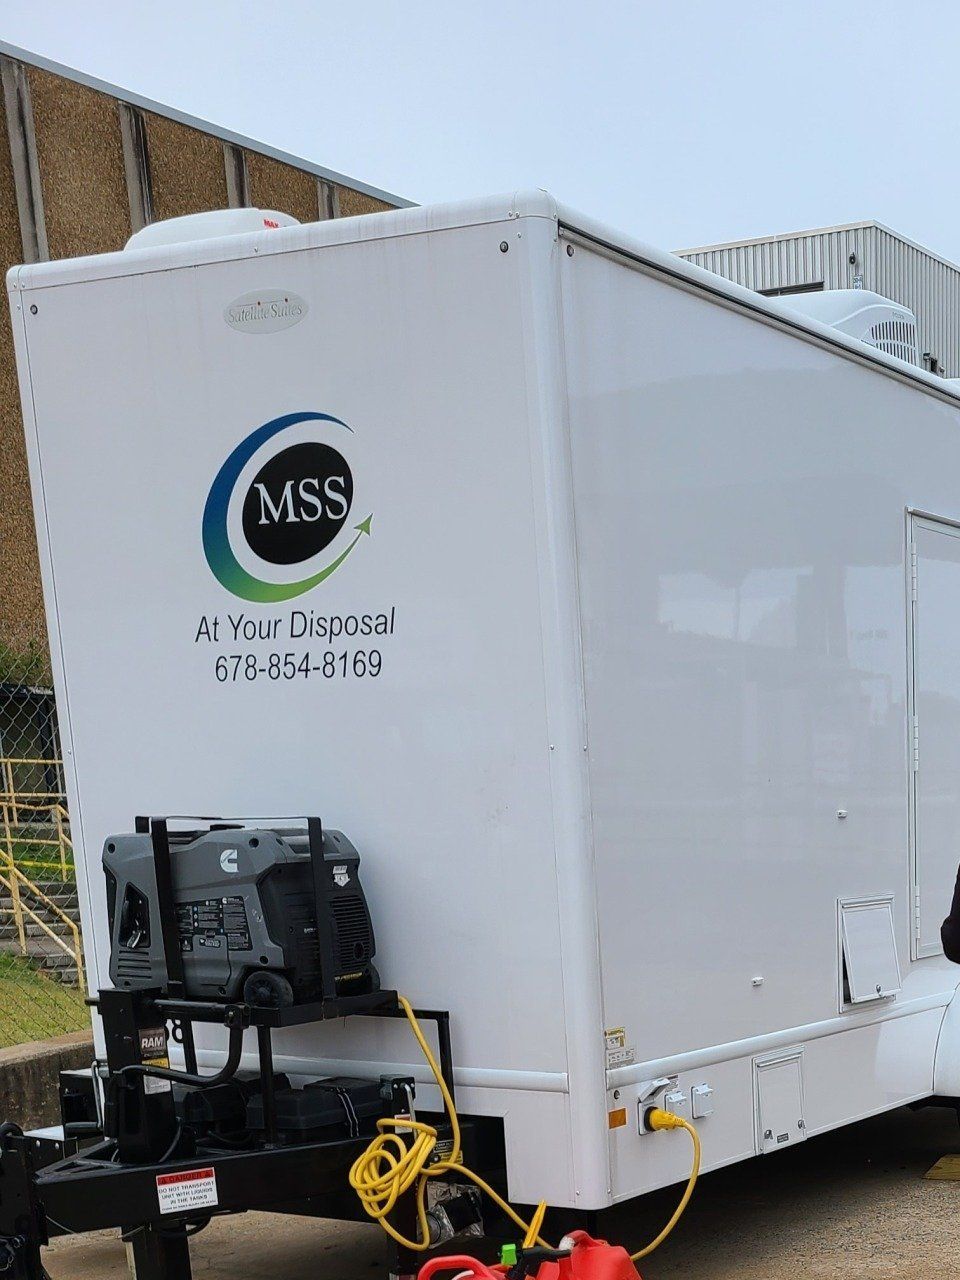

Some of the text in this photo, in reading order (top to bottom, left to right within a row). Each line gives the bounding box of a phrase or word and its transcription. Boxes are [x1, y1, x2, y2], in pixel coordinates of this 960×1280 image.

[228, 302, 269, 323] Satellite
[254, 475, 348, 526] MSS
[195, 607, 395, 644] At Your Disposal
[215, 649, 383, 683] 678-854-8169
[141, 1037, 164, 1049] RAM
[181, 1181, 214, 1190] TRANSPORT
